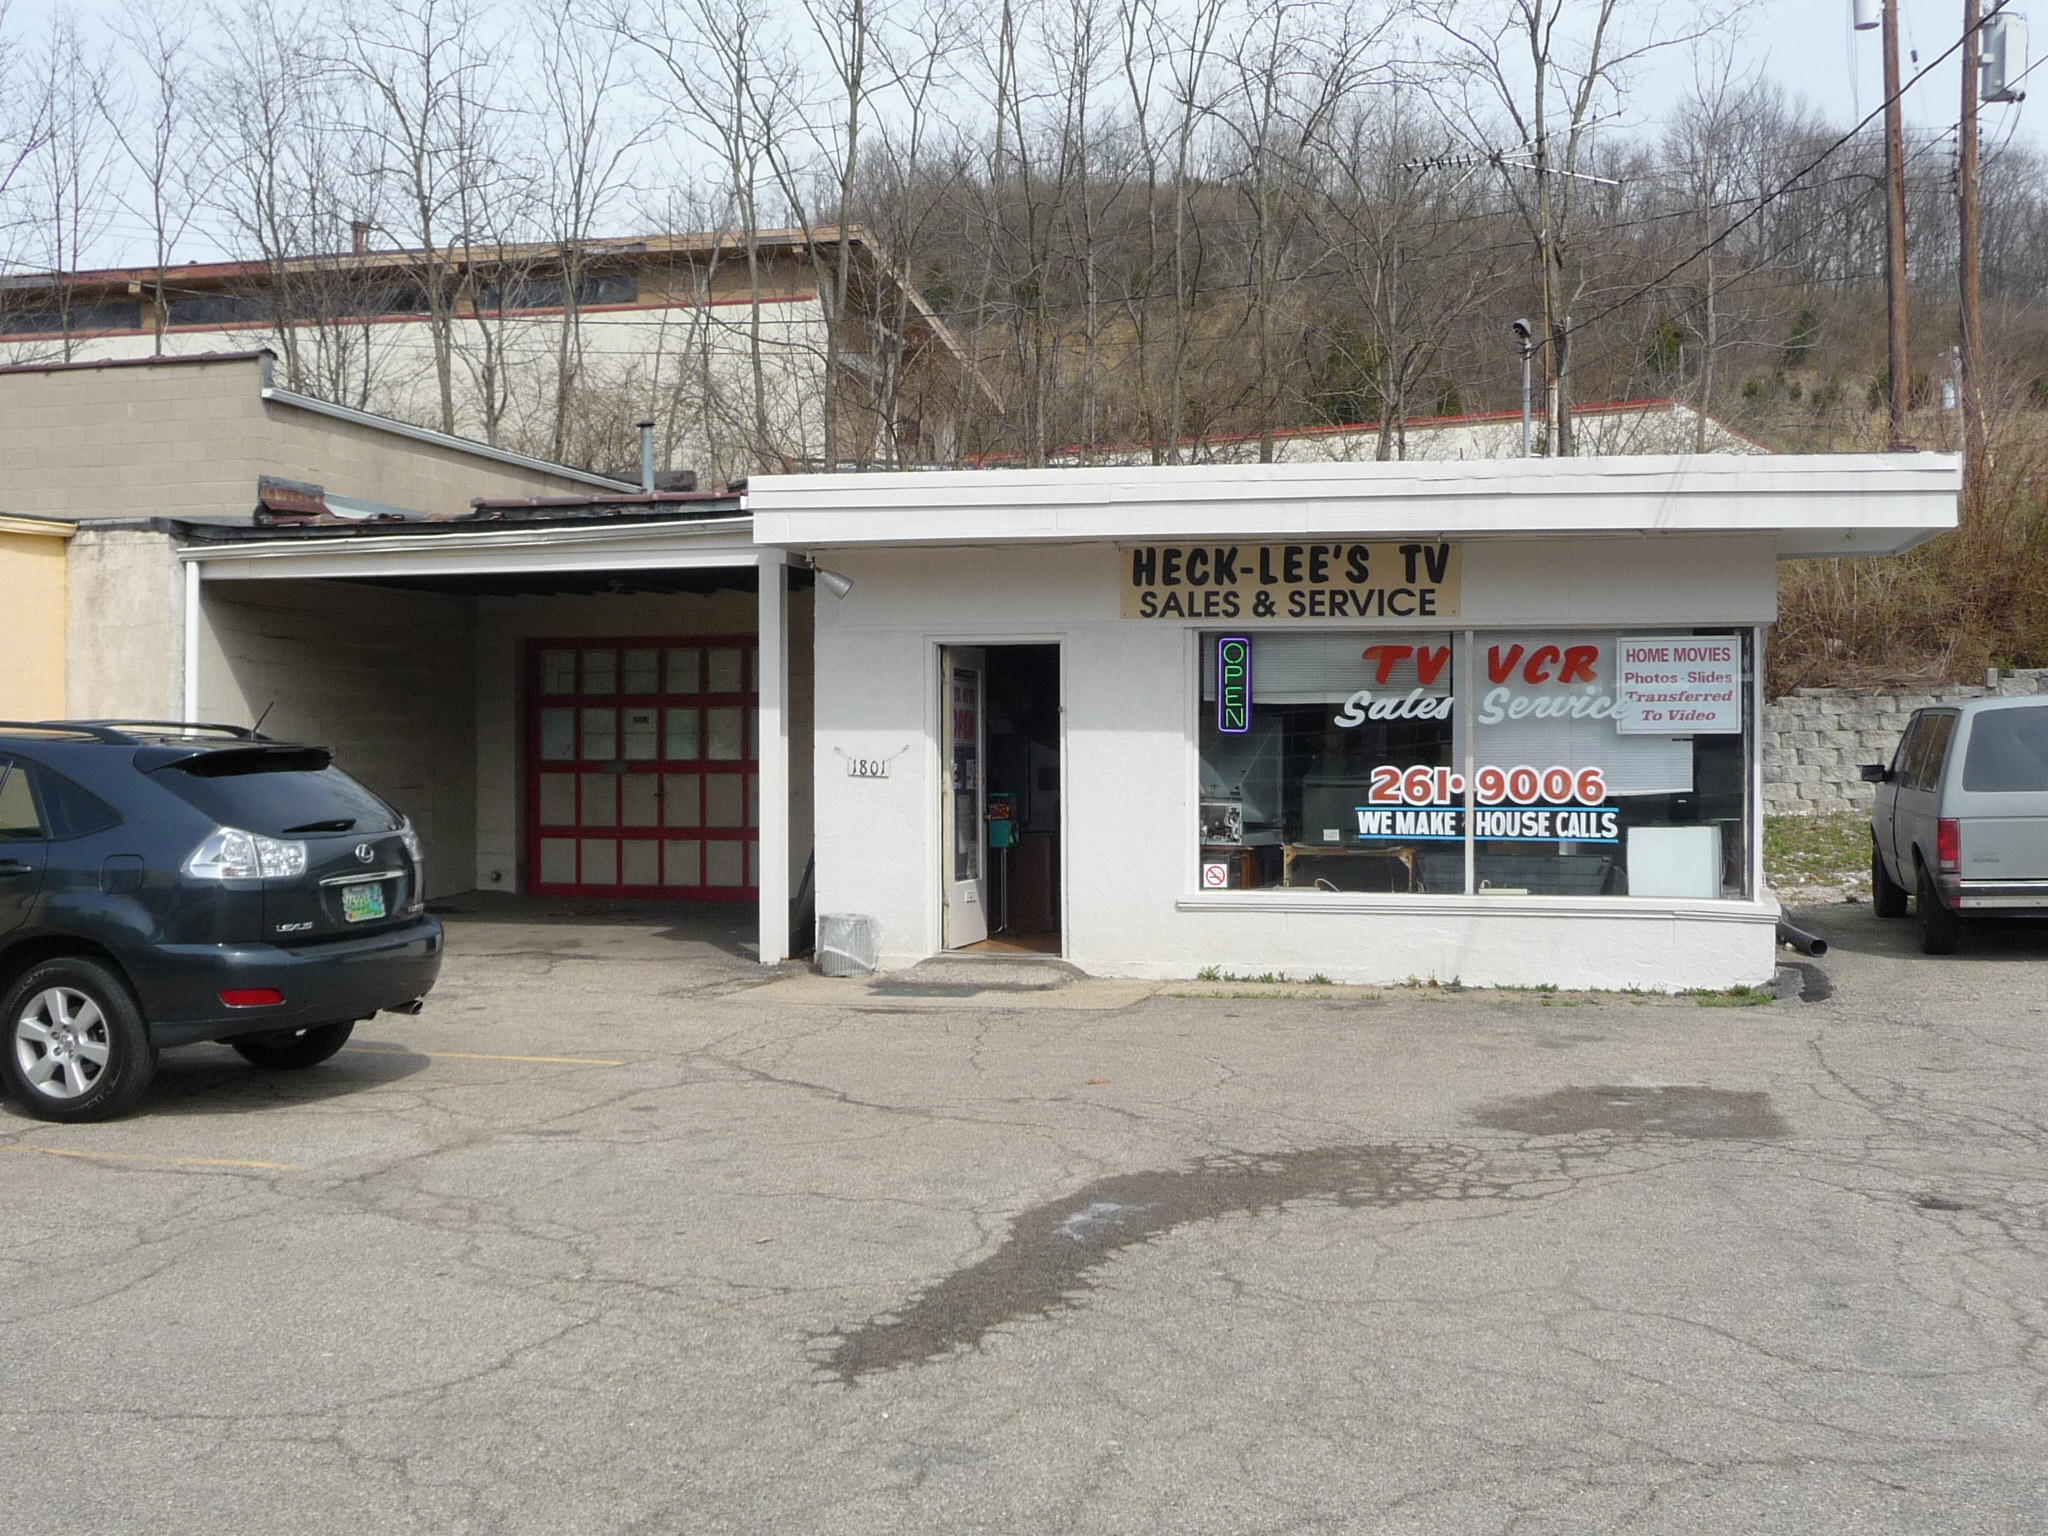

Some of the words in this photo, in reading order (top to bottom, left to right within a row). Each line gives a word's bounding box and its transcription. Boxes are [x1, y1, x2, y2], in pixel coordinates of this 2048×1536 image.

[1132, 545, 1369, 586] HECK-LEE'S
[1399, 543, 1449, 584] TV
[1140, 591, 1240, 618] SALES
[1252, 592, 1276, 617] &
[1288, 588, 1436, 617] SERVICE
[1362, 645, 1450, 685] TV
[1487, 644, 1599, 685] VCR
[1626, 648, 1669, 663] HOME
[1673, 647, 1731, 662] MOVIES
[1223, 643, 1244, 727] OPEN
[1624, 672, 1678, 684] Photos
[1687, 671, 1732, 683] Slides
[1334, 688, 1454, 728] Sales
[1477, 686, 1634, 725] Service
[1625, 690, 1733, 703] Transferred
[1641, 710, 1663, 721] To
[1668, 709, 1716, 721] Video
[851, 759, 886, 776] 1801
[1357, 811, 1392, 835] WE
[1395, 812, 1456, 836] MAKE
[1475, 812, 1550, 836] HOUSE
[1555, 812, 1618, 838] CALLS
